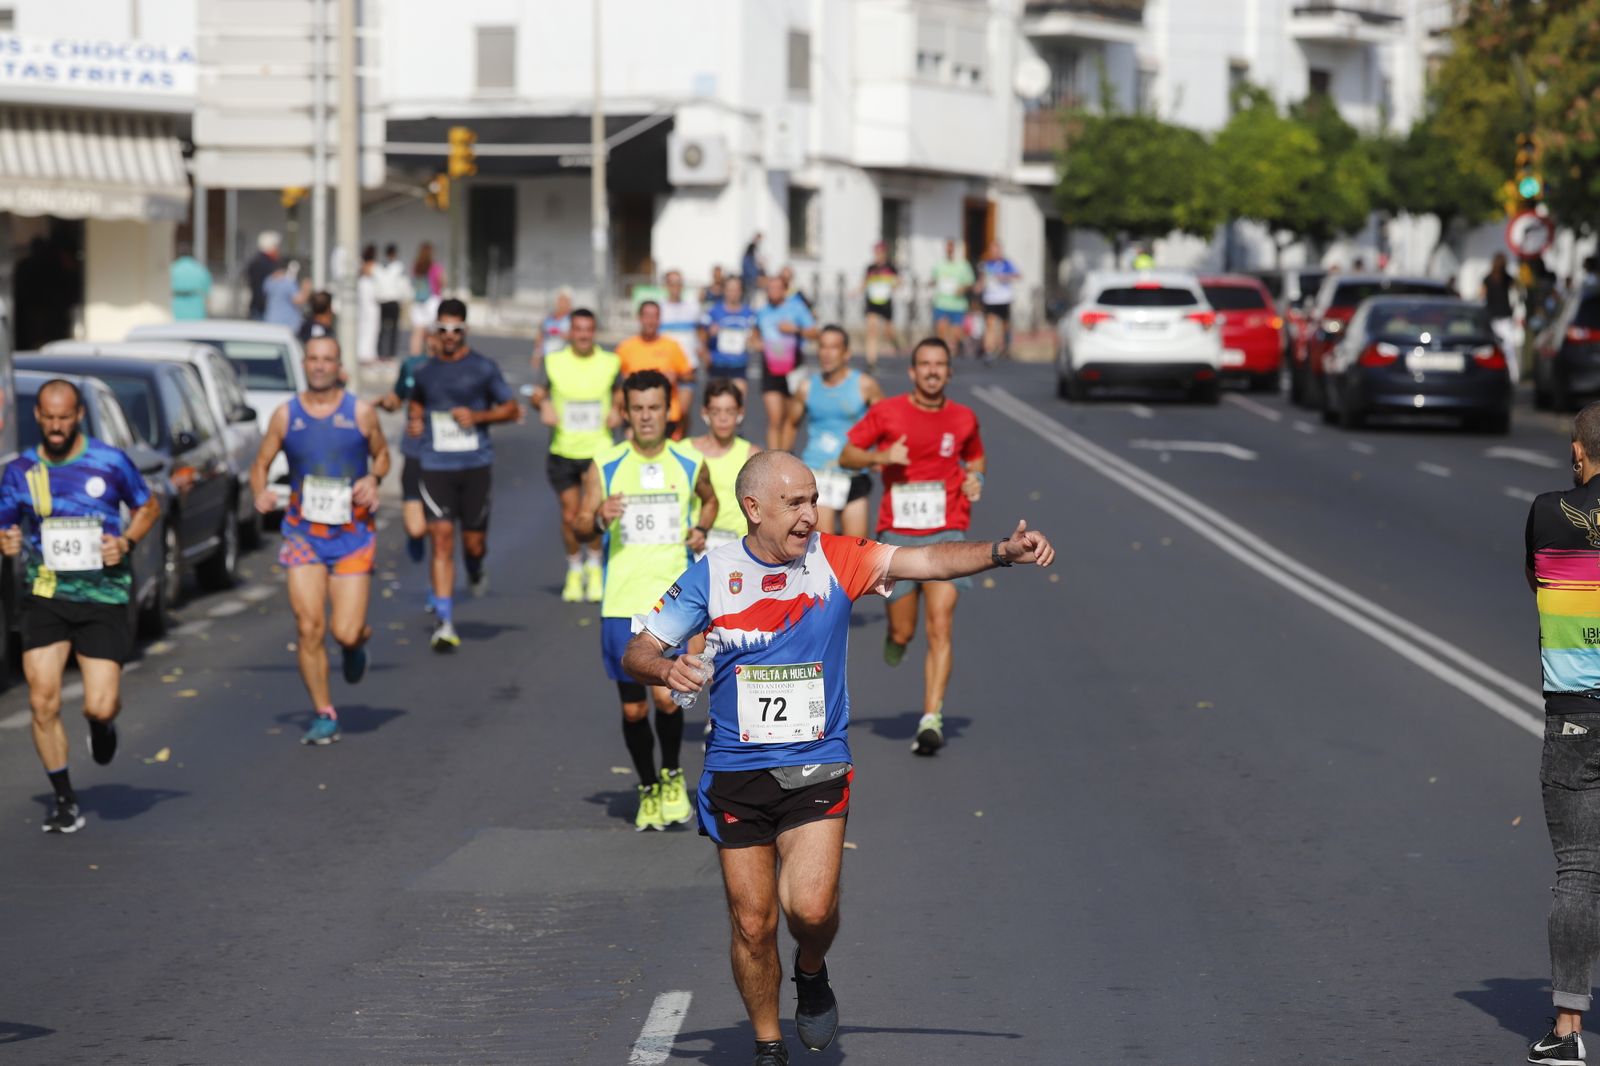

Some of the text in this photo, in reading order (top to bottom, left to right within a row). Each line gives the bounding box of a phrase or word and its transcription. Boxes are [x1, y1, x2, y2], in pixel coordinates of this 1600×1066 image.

[51, 40, 195, 63] CHOCOLA
[68, 66, 174, 86] FRITAS
[902, 501, 928, 516] 614
[635, 514, 655, 531] 86
[52, 539, 81, 556] 649
[752, 669, 780, 680] VUELTA
[782, 669, 789, 680] A
[790, 667, 818, 679] HUELVA
[765, 682, 795, 690] ANTONIO
[758, 697, 788, 722] 72
[830, 768, 846, 777] SPORT
